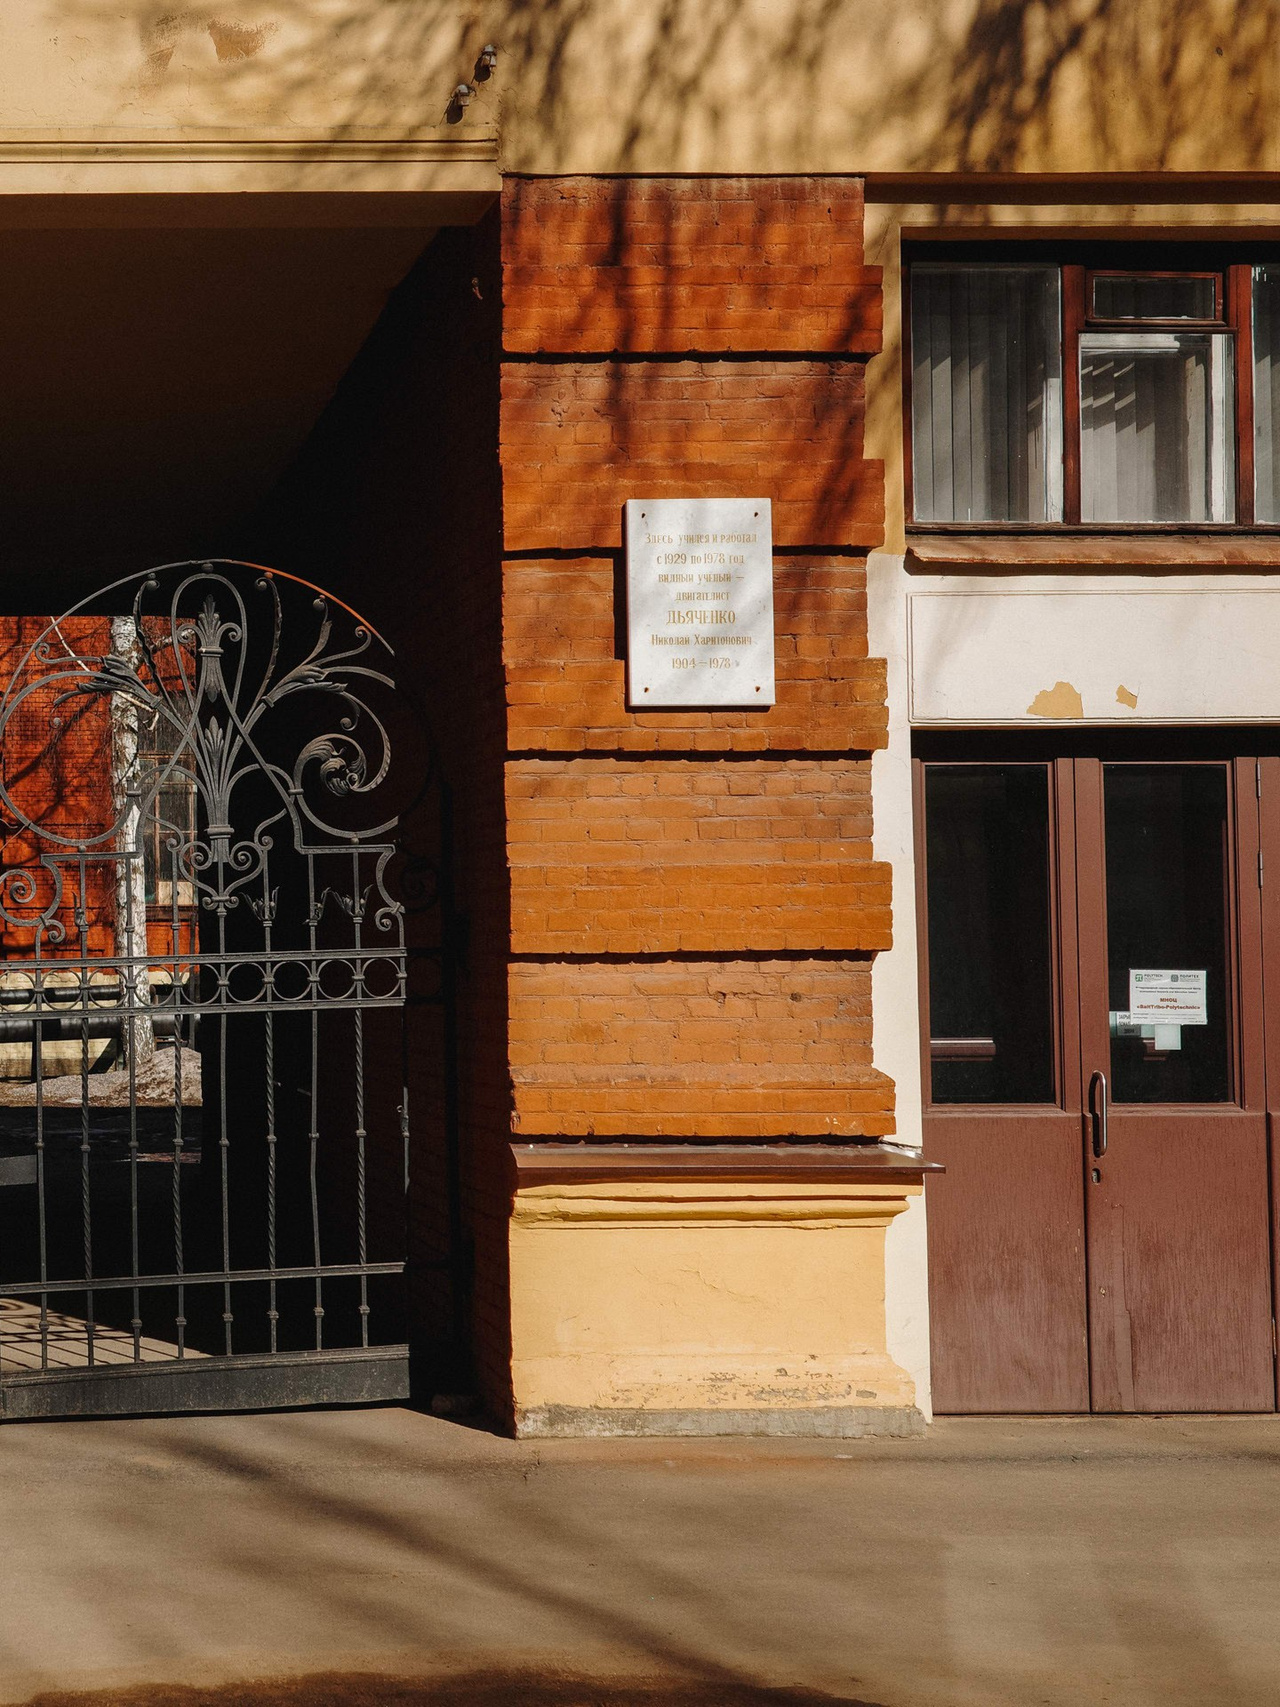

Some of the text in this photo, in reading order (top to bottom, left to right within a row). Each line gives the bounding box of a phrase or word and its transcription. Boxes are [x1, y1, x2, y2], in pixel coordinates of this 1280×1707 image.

[646, 533, 757, 546] Здесь учился и работал
[665, 553, 687, 564] 1929
[690, 555, 702, 564] по
[704, 553, 725, 564] 1978
[729, 555, 744, 564] год
[674, 591, 731, 601] двигателист
[666, 610, 736, 625] ДЬЯЧЕНКО
[651, 634, 752, 646] Николай Харитонович
[672, 657, 696, 669] 1904
[709, 657, 731, 669] 1978
